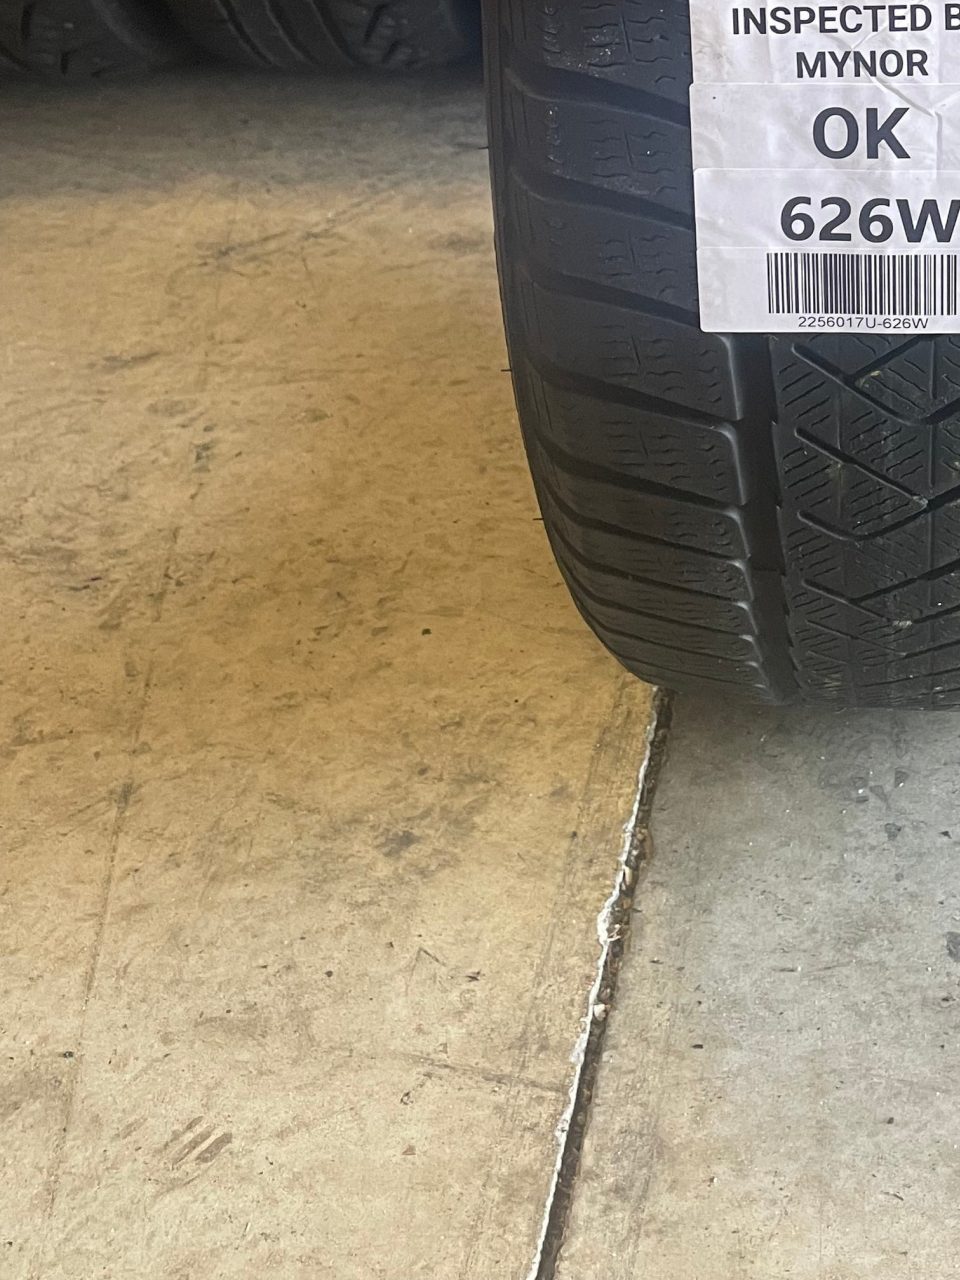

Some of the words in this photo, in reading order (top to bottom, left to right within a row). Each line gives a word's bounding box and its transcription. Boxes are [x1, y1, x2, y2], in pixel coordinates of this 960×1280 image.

[731, 4, 932, 35] INSPECTED
[796, 49, 929, 79] MYNOR
[812, 106, 911, 159] OK
[797, 315, 929, 330] 2256017U-626W
